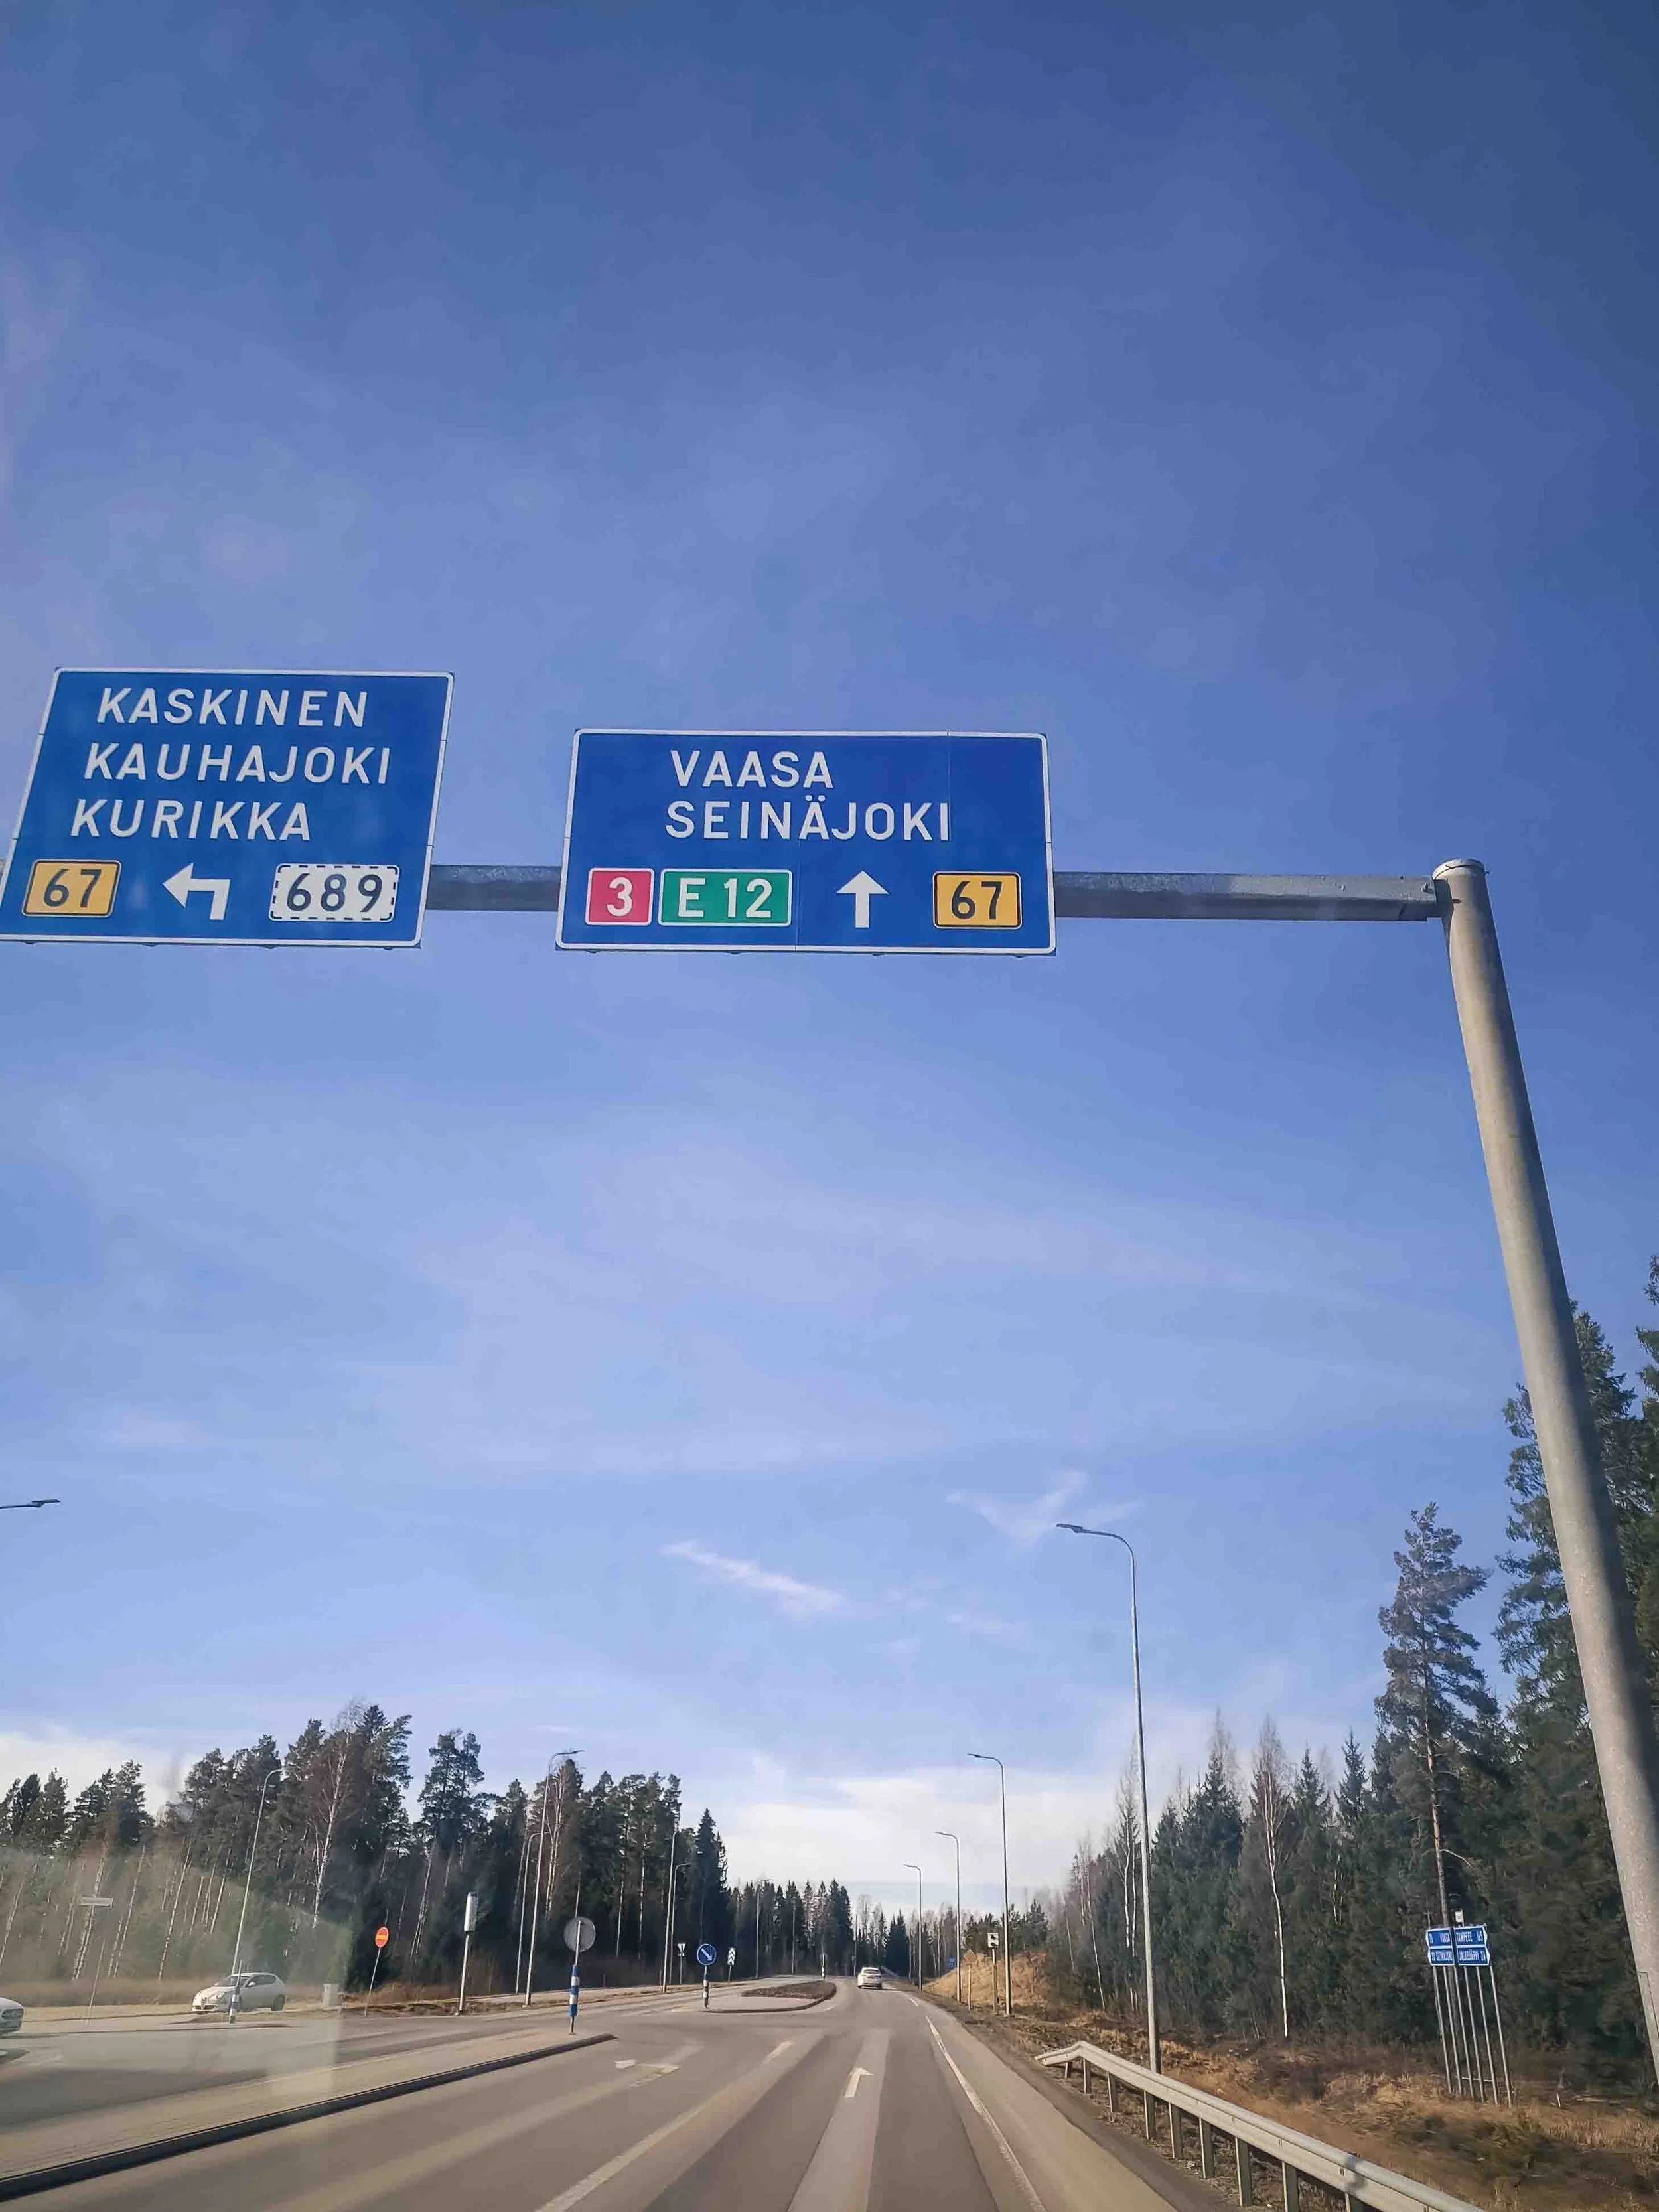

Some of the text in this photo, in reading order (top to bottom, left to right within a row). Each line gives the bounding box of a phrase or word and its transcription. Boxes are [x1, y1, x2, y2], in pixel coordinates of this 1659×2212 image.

[98, 688, 366, 726] KASKINEN
[85, 743, 389, 783] KAUHAJOKI
[671, 751, 833, 788] VAASA
[71, 800, 309, 840] KURIKKA
[666, 795, 949, 840] SEINÄJOKI
[44, 869, 102, 907] 67
[287, 873, 382, 912] 689
[607, 877, 632, 916] 3
[952, 881, 1002, 919] 67
